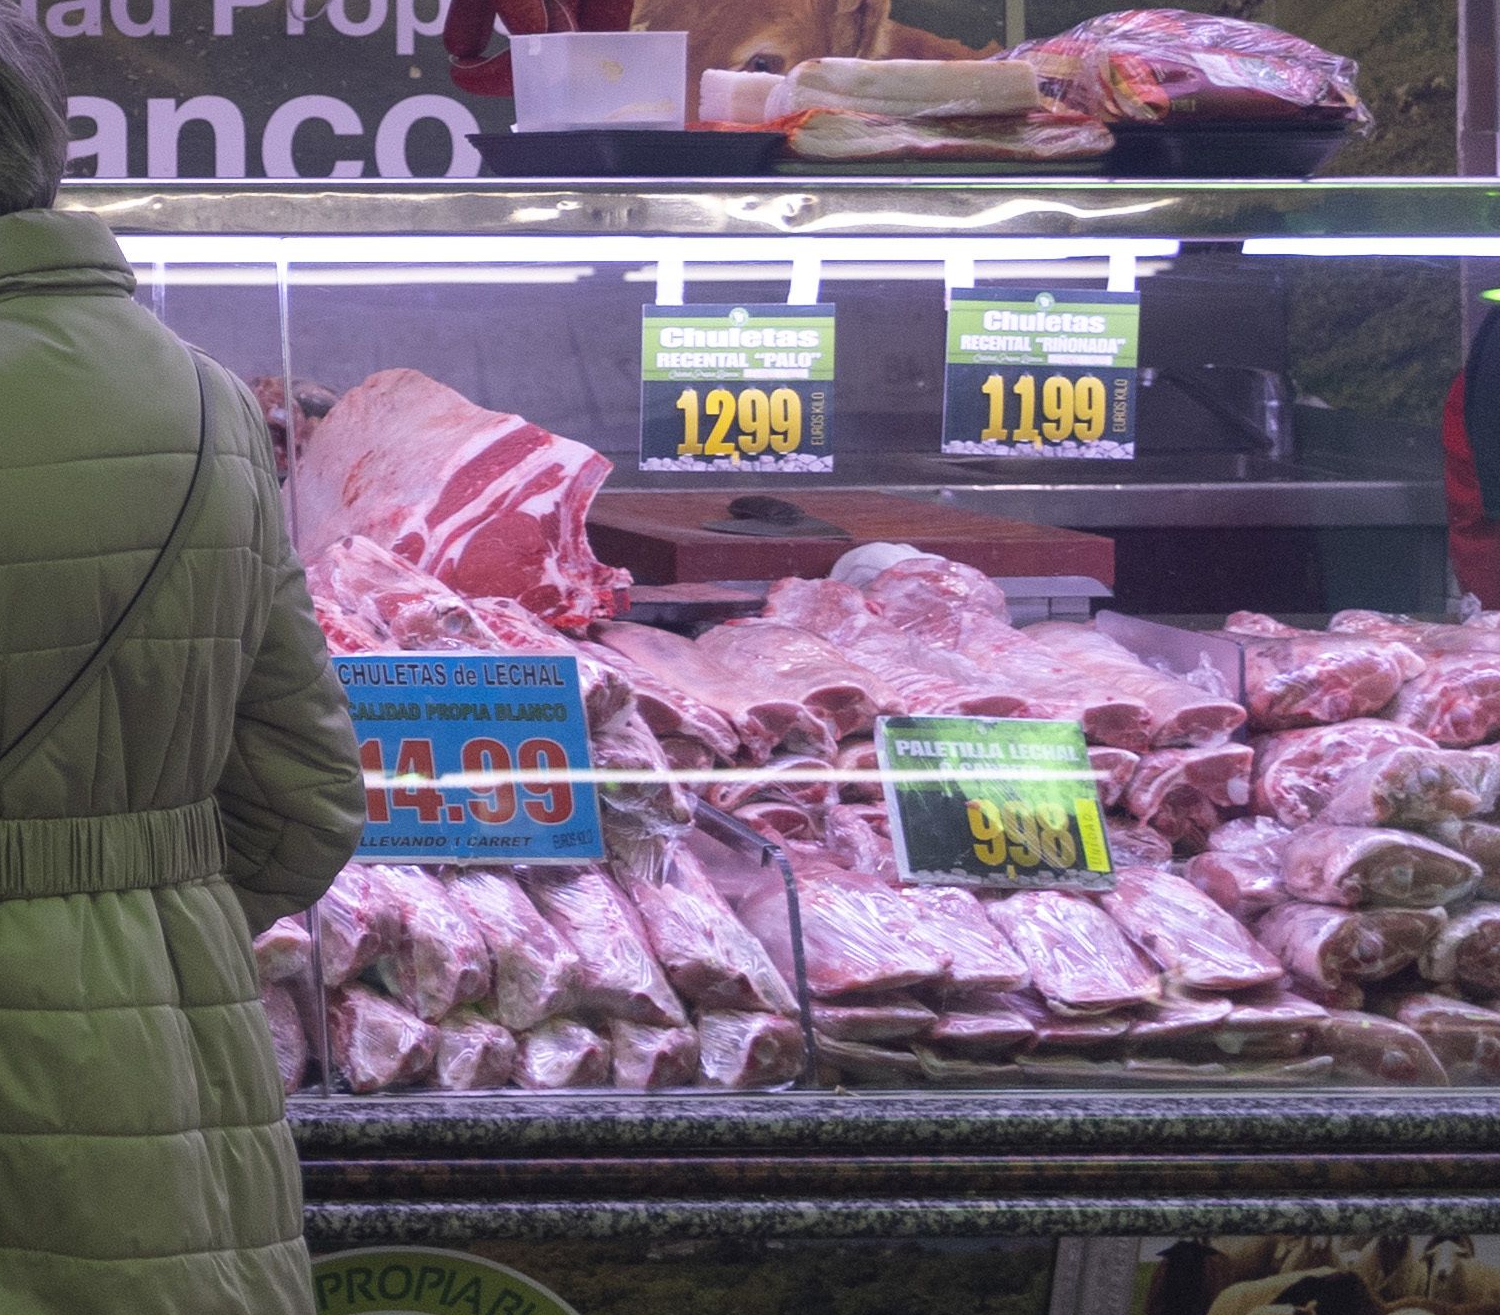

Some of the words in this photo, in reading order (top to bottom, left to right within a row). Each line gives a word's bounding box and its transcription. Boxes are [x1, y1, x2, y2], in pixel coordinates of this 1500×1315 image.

[983, 309, 1106, 335] Chuletas
[960, 335, 1032, 353] RECENTAL
[337, 664, 447, 686] CHULETAS
[454, 664, 477, 685] de
[484, 664, 565, 686] LECHAL
[894, 739, 1005, 759] PALETILLA
